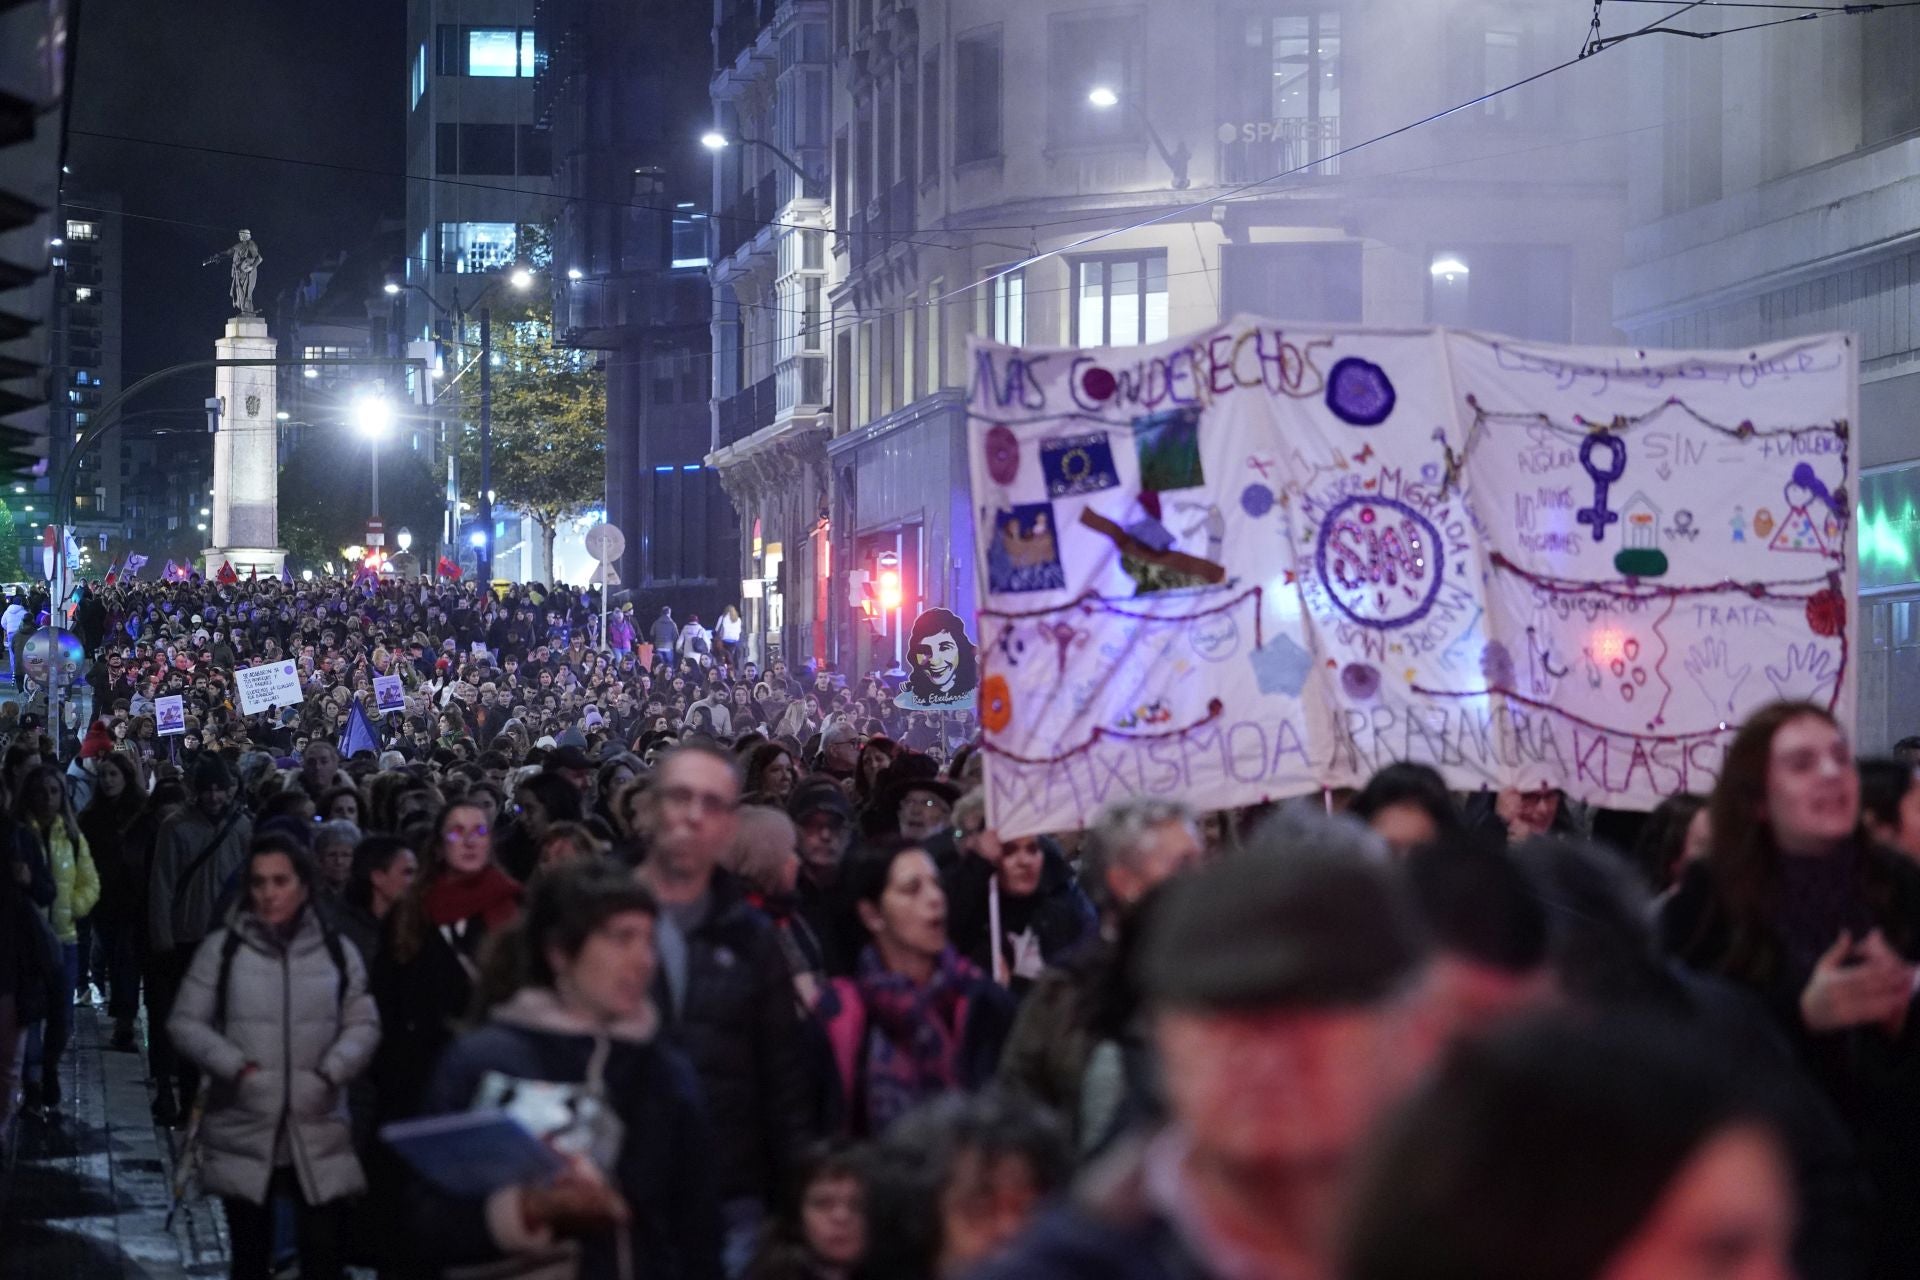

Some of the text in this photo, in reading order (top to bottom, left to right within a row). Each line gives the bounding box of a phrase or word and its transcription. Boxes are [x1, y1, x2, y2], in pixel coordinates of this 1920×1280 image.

[1642, 432, 1707, 466] SIN
[1694, 605, 1775, 628] TRATA
[1573, 729, 1728, 796] KLASIS
